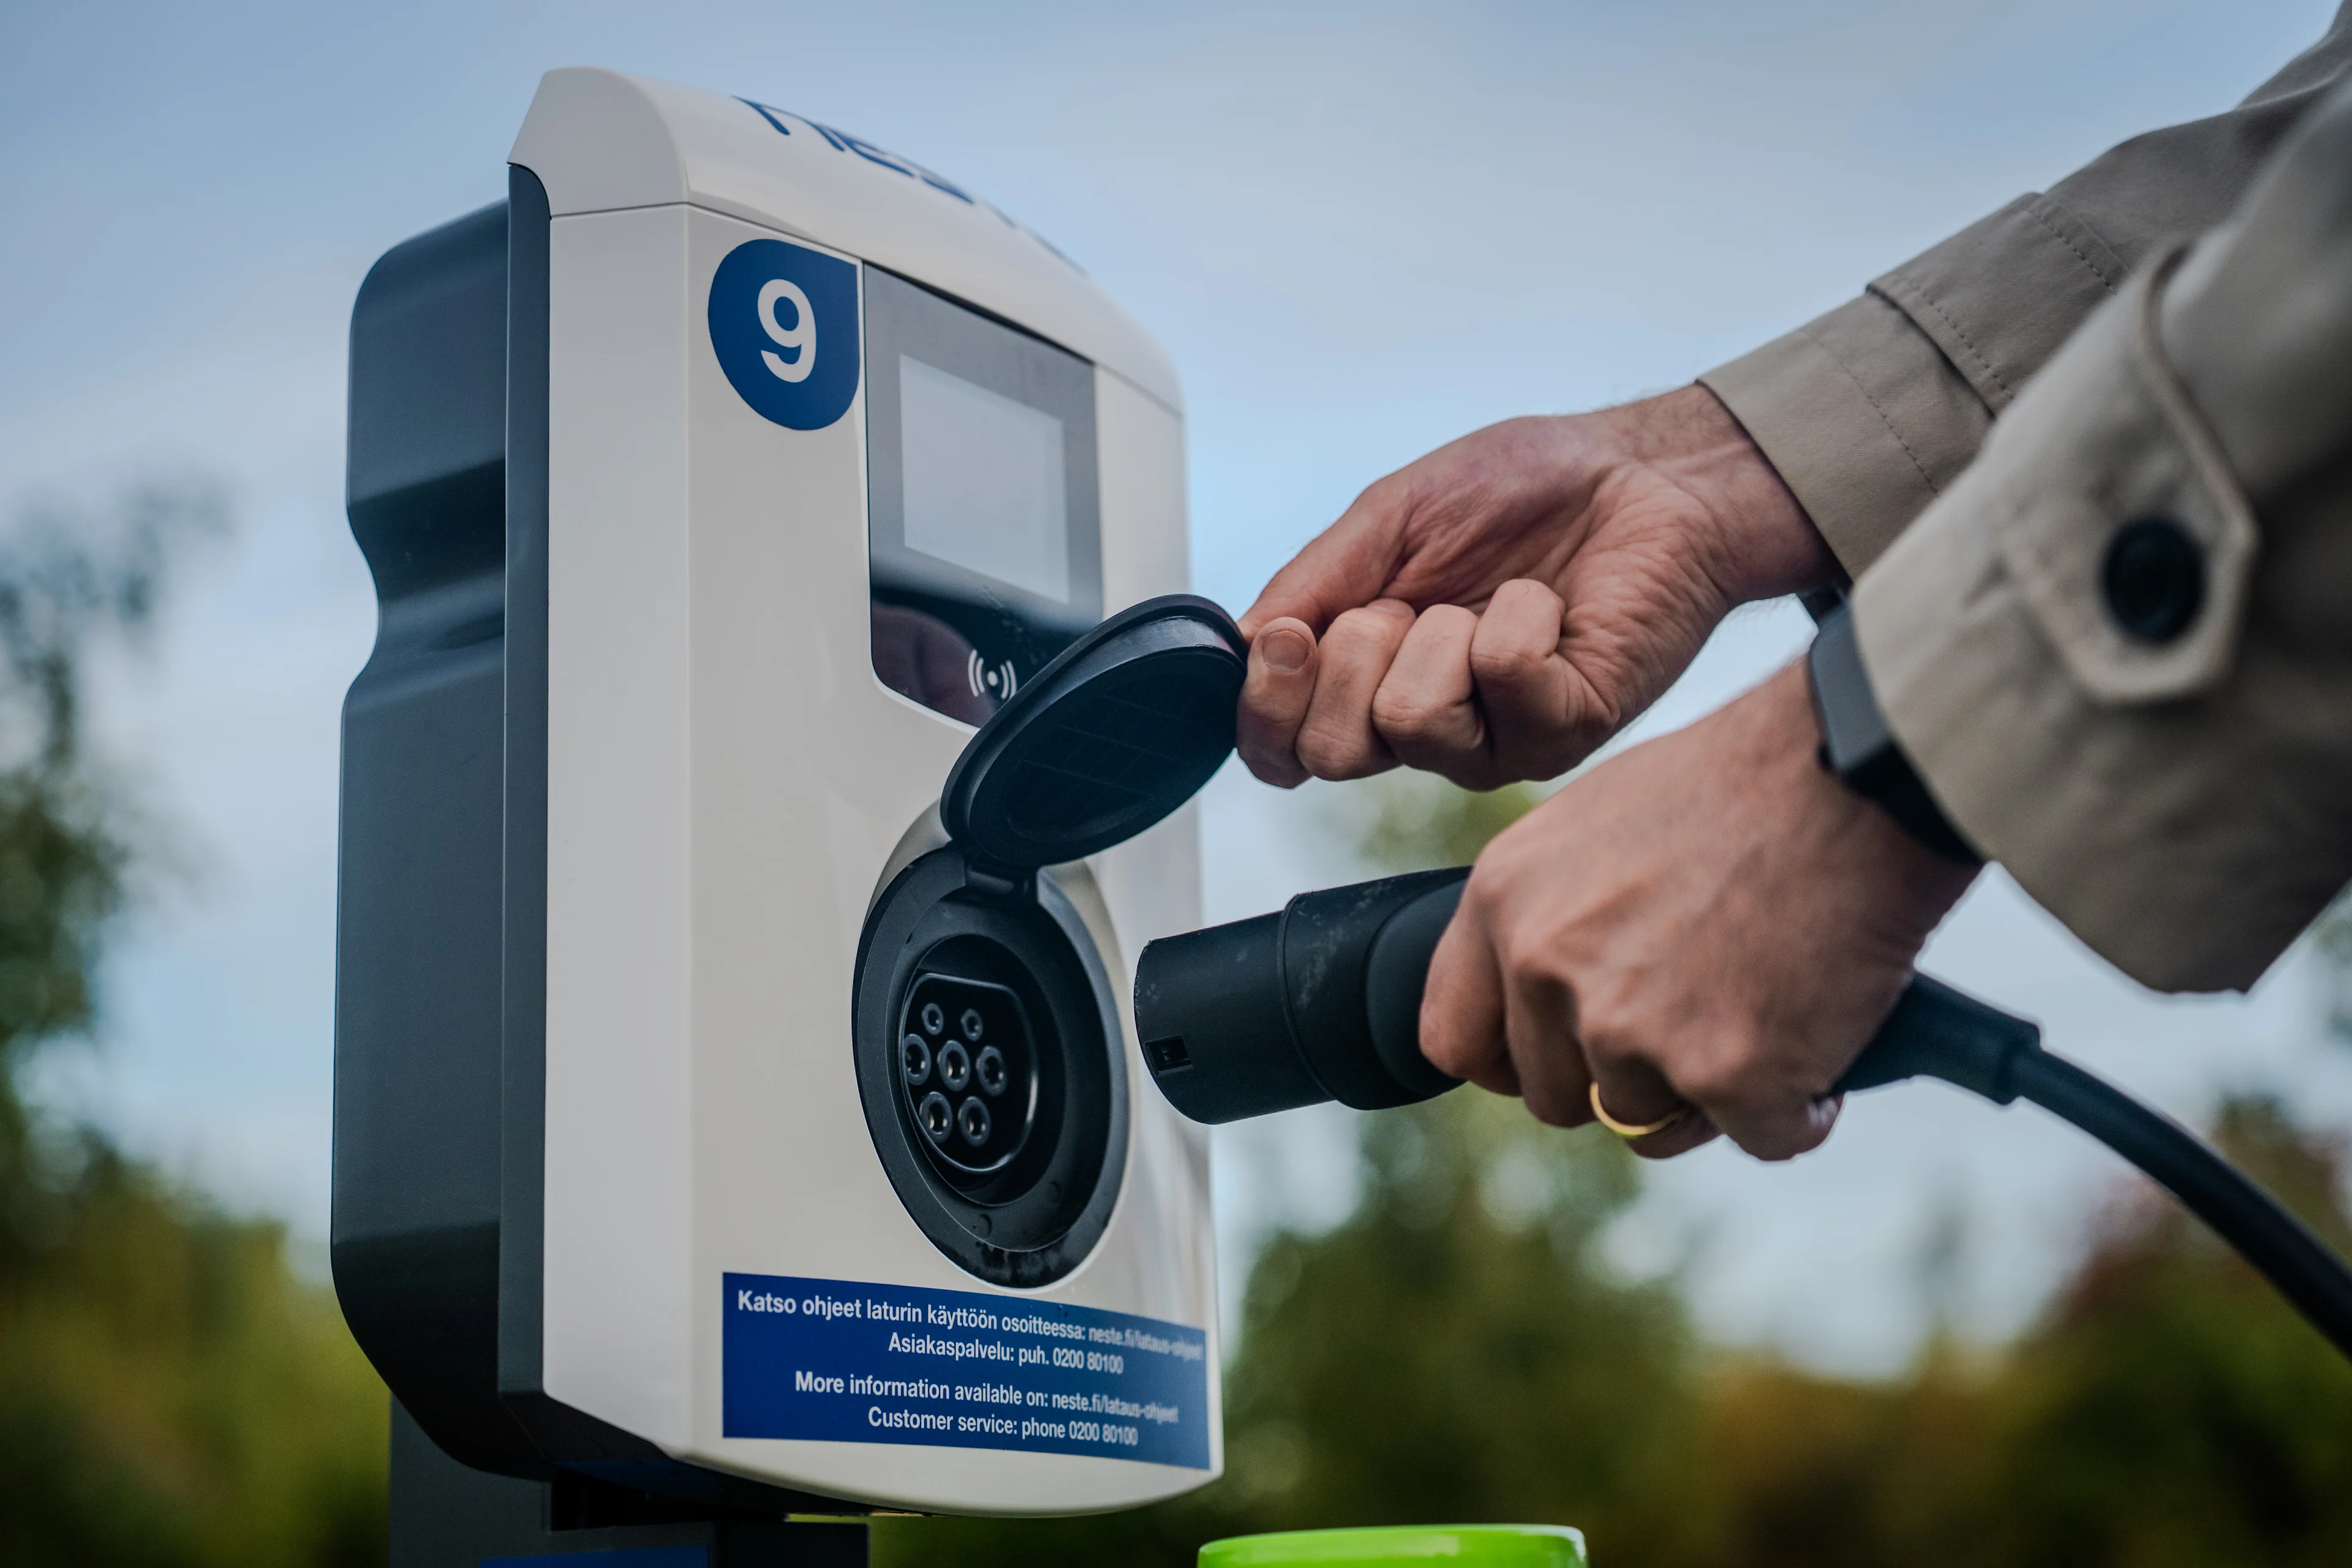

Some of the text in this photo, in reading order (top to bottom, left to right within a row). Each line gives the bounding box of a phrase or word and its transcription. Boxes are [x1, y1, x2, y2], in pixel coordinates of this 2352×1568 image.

[757, 278, 816, 383] 9
[737, 1290, 796, 1314] Katso
[802, 1295, 862, 1321] ohjeet
[867, 1298, 922, 1323] laturin
[927, 1304, 998, 1330] käyttöön
[1001, 1314, 1086, 1340] osoitteessa:
[888, 1332, 1125, 1374] Asiakaspalvelu: puh. 0200 80100
[795, 1370, 845, 1394] More
[850, 1373, 950, 1400] information
[954, 1382, 1022, 1405] available
[1025, 1391, 1049, 1408] on:
[867, 1406, 1139, 1446] Customer service: phone 0200 80100
